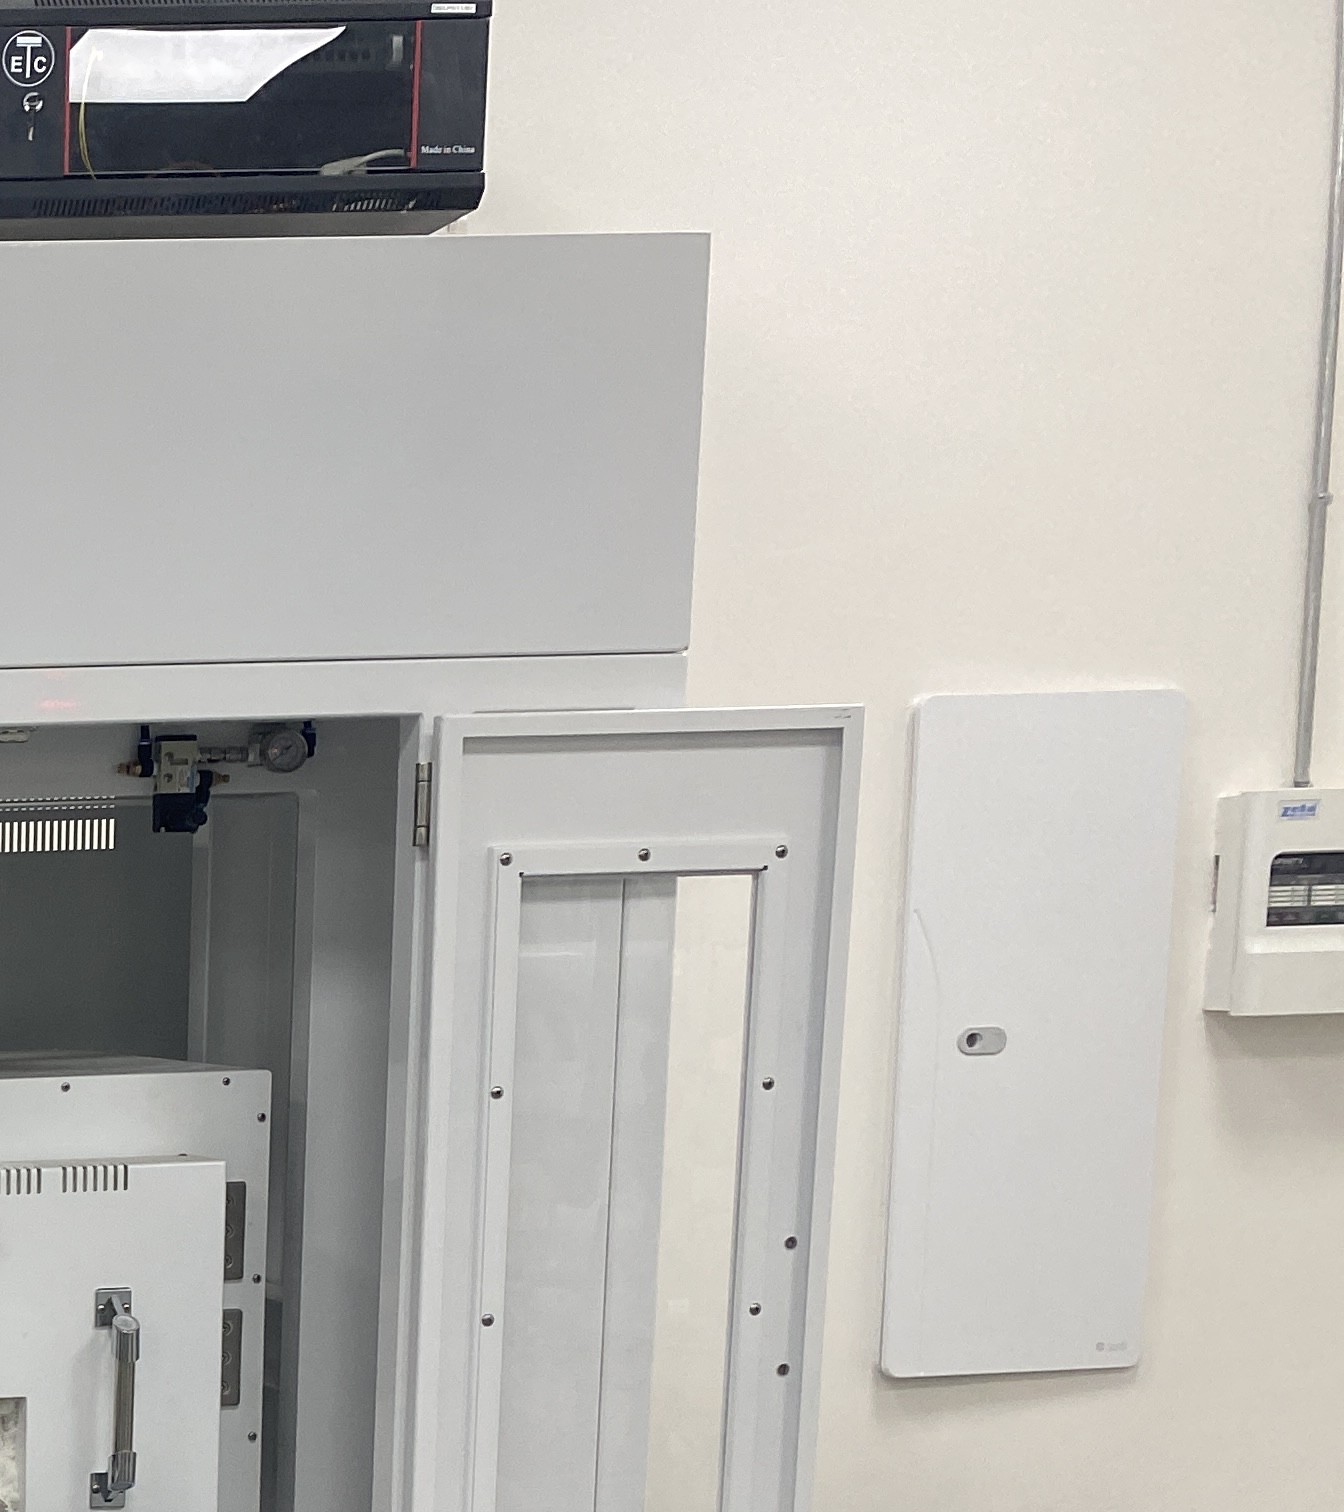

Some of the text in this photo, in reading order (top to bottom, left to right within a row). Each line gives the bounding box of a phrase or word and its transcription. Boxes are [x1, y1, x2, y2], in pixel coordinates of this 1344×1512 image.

[421, 145, 475, 154] Made in China
